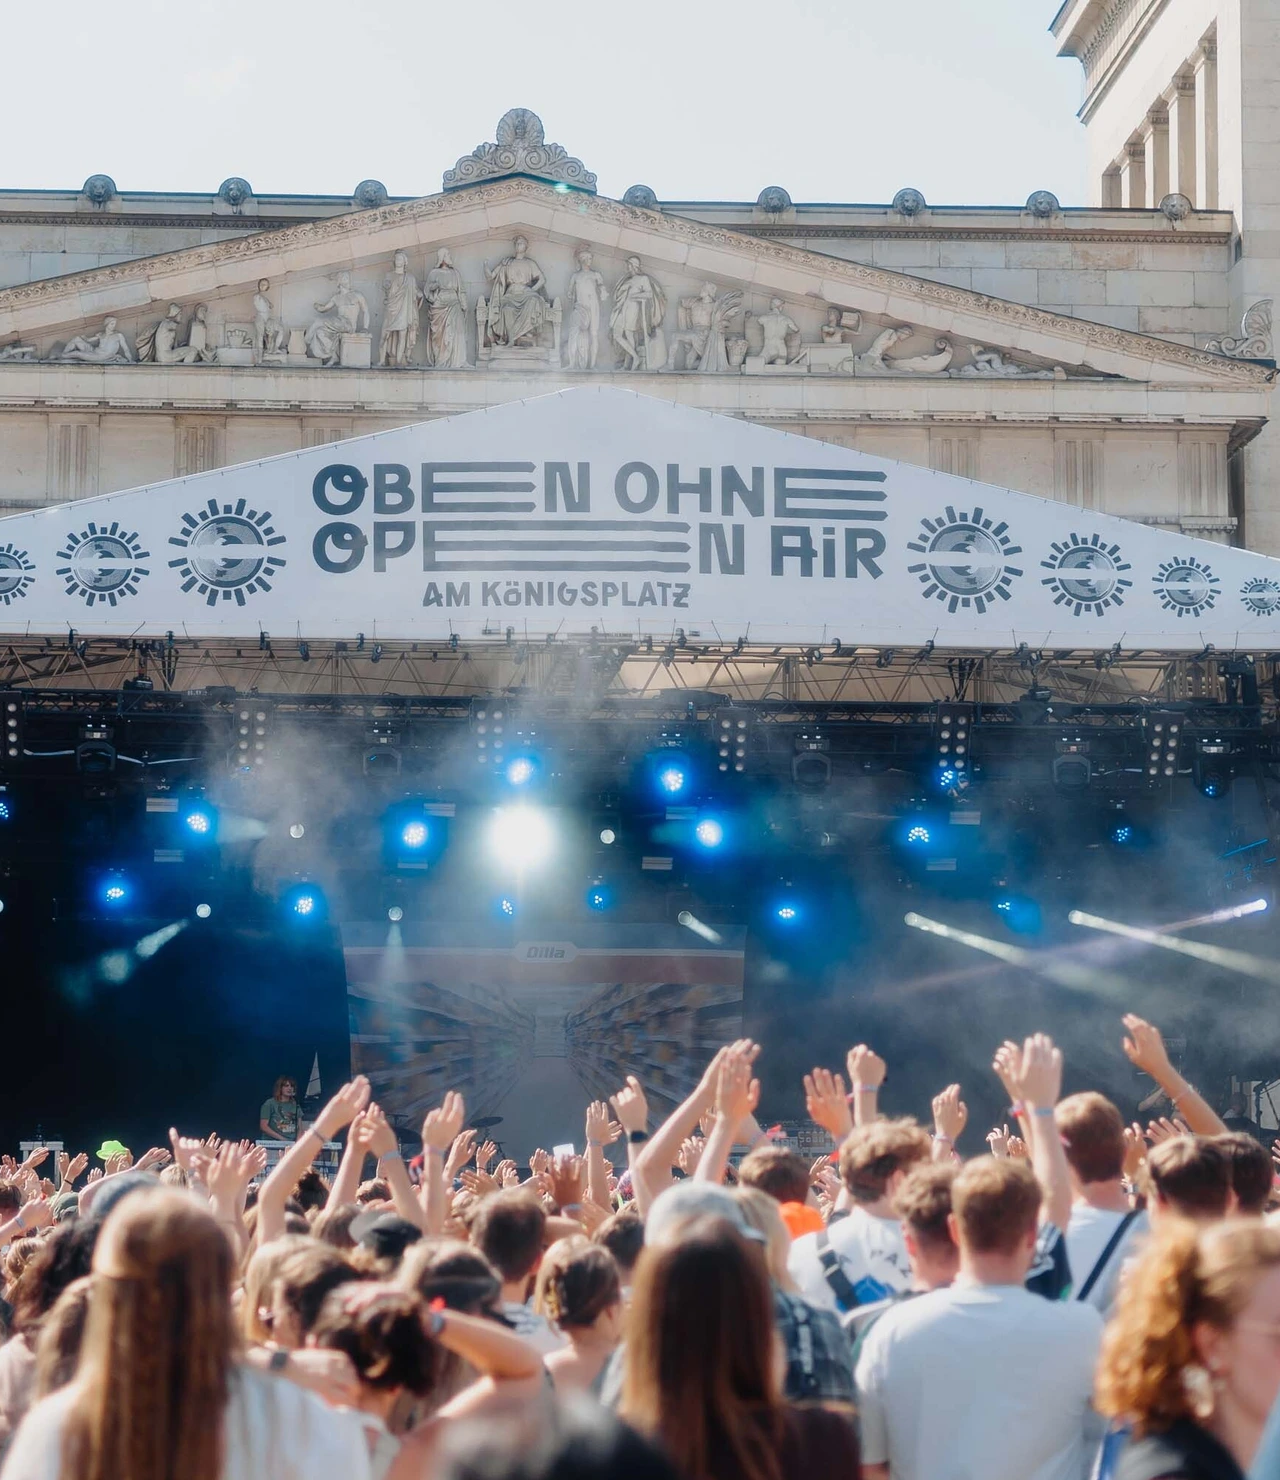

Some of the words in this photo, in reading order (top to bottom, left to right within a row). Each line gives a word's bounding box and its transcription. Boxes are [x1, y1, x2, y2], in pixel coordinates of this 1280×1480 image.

[312, 462, 590, 516] OBEN
[614, 461, 889, 522] OHNE
[312, 520, 745, 575] OPEN
[422, 581, 470, 607] AM
